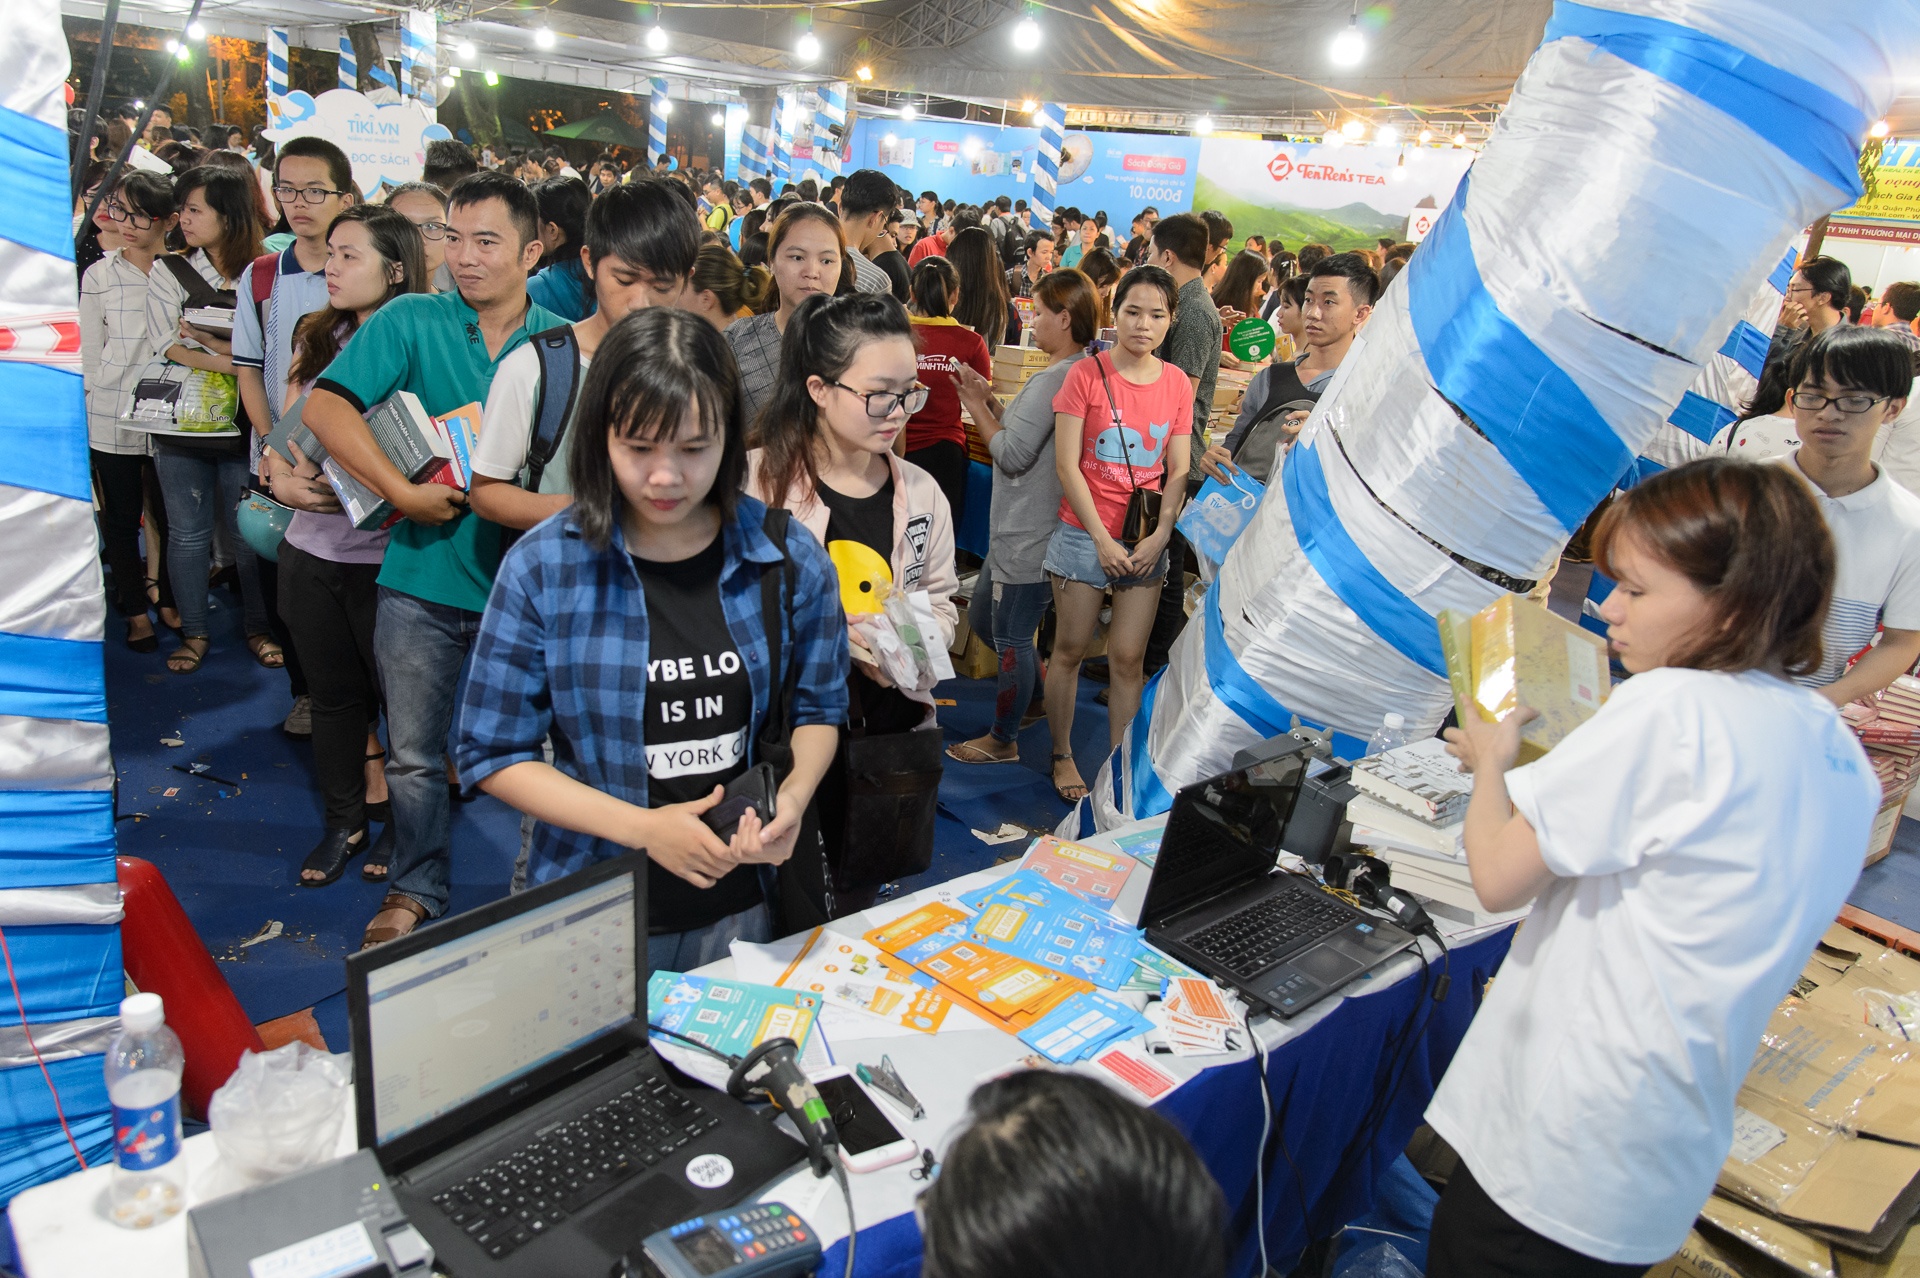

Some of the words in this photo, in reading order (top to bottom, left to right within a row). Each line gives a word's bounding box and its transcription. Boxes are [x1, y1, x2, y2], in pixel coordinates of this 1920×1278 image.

[380, 151, 410, 166] SÁCH
[1127, 157, 1145, 168] Sách
[1168, 160, 1181, 171] Giá
[1356, 174, 1385, 185] TEA
[1129, 185, 1183, 202] 10.000đ
[1838, 227, 1859, 235] TNHH
[1861, 228, 1894, 238] THƯƠNG
[1895, 231, 1911, 240] MẠI
[1099, 464, 1124, 476] whale
[1101, 472, 1116, 482] you
[1118, 476, 1131, 484] are
[661, 700, 686, 723] IS
[695, 695, 723, 719] IN
[664, 744, 723, 769] YORK
[773, 1013, 792, 1028] 01
